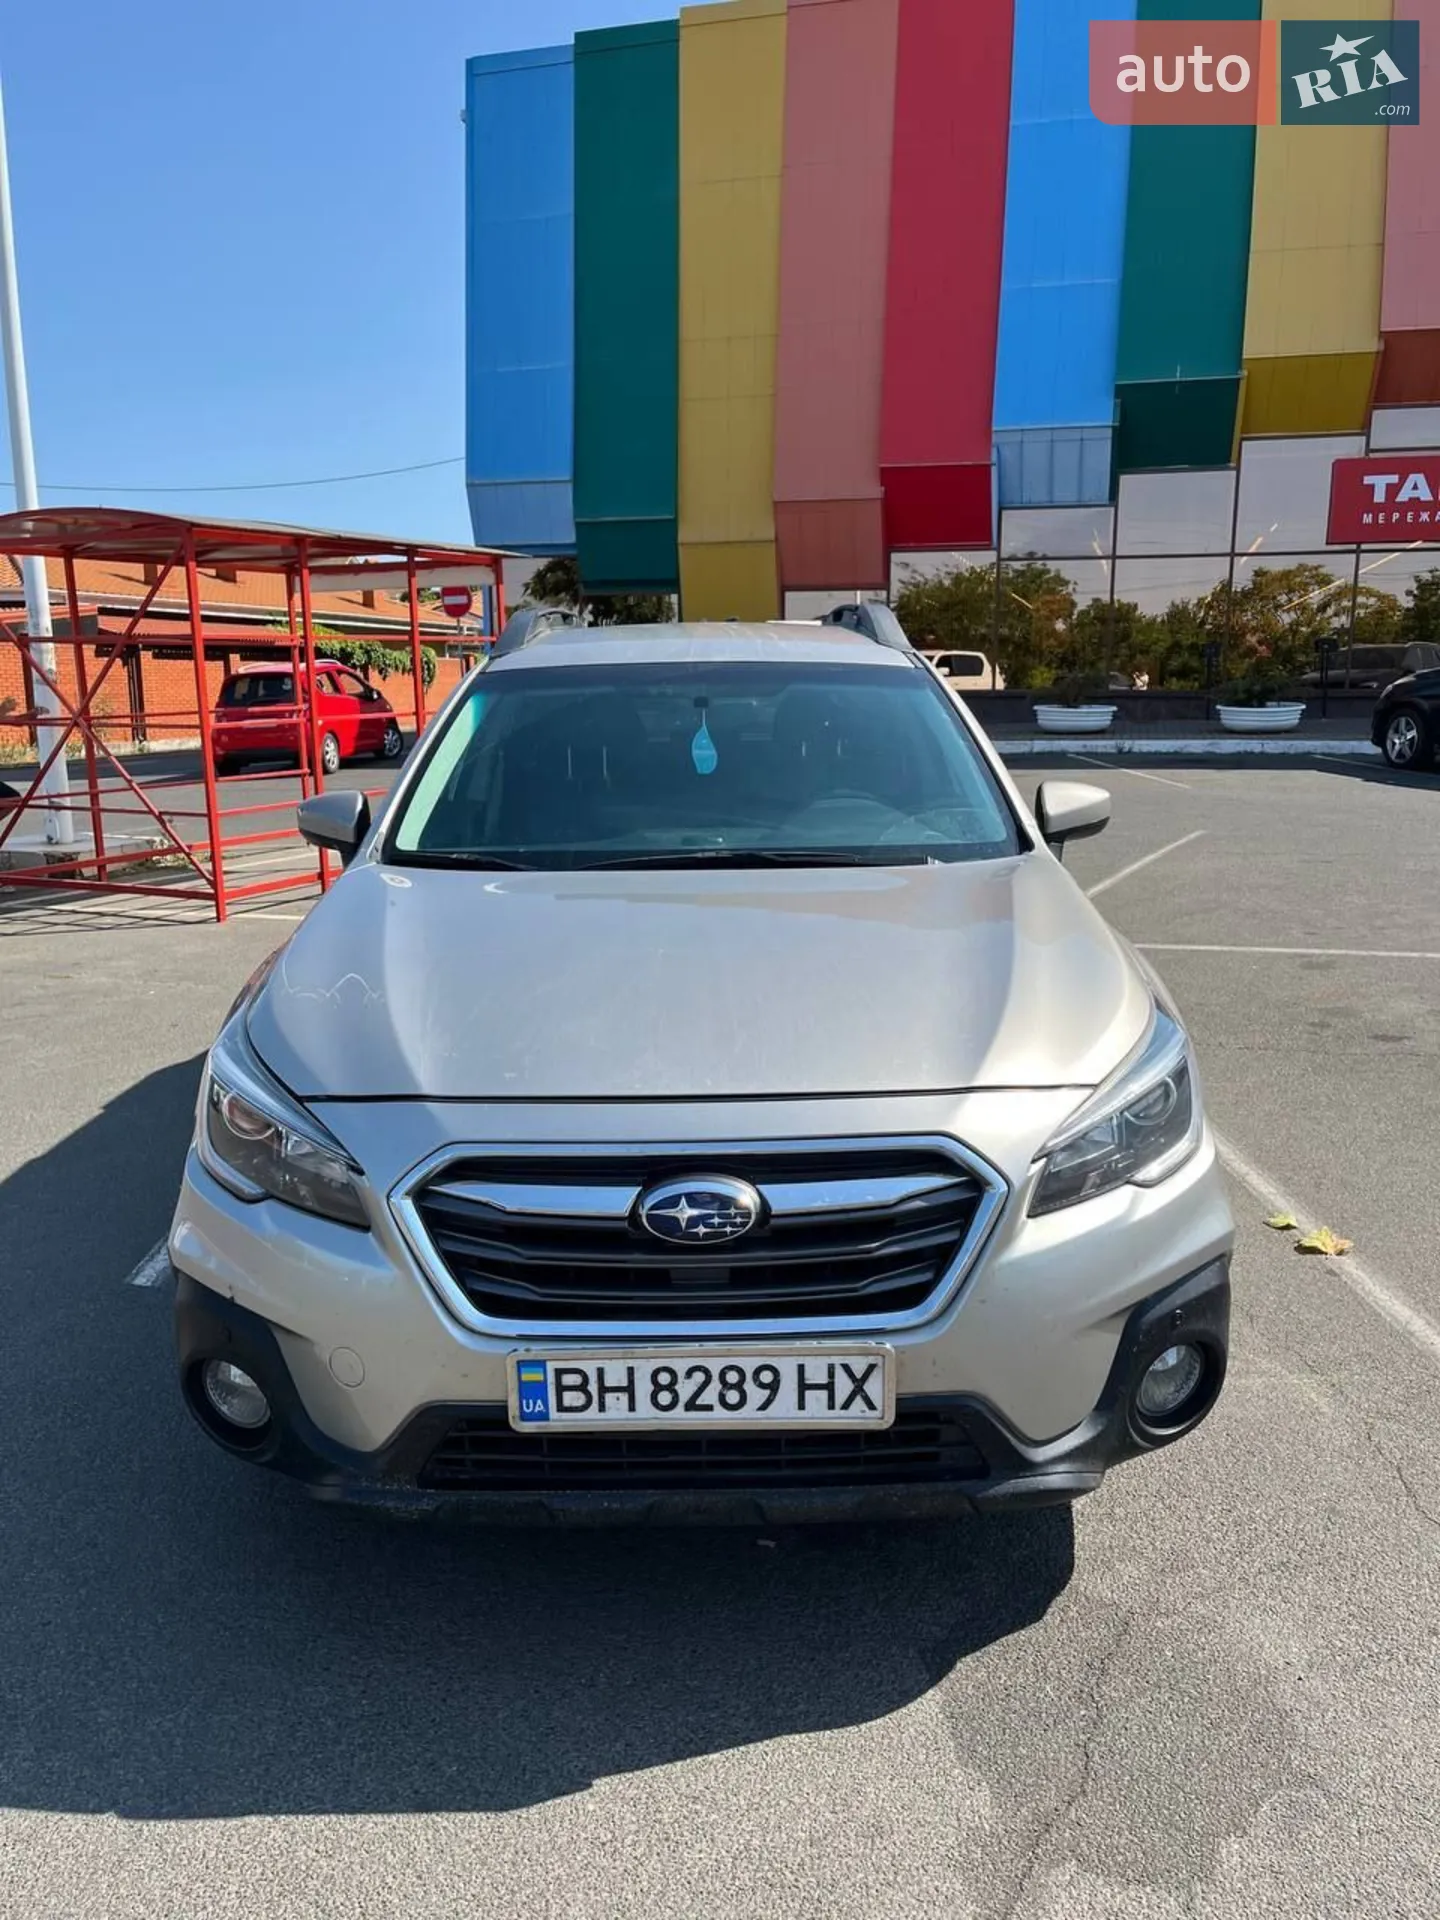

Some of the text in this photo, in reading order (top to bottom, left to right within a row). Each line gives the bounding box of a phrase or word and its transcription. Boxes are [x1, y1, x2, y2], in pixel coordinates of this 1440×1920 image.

[1362, 473, 1440, 503] ТА
[523, 1363, 878, 1413] UA BH 8289 HX
